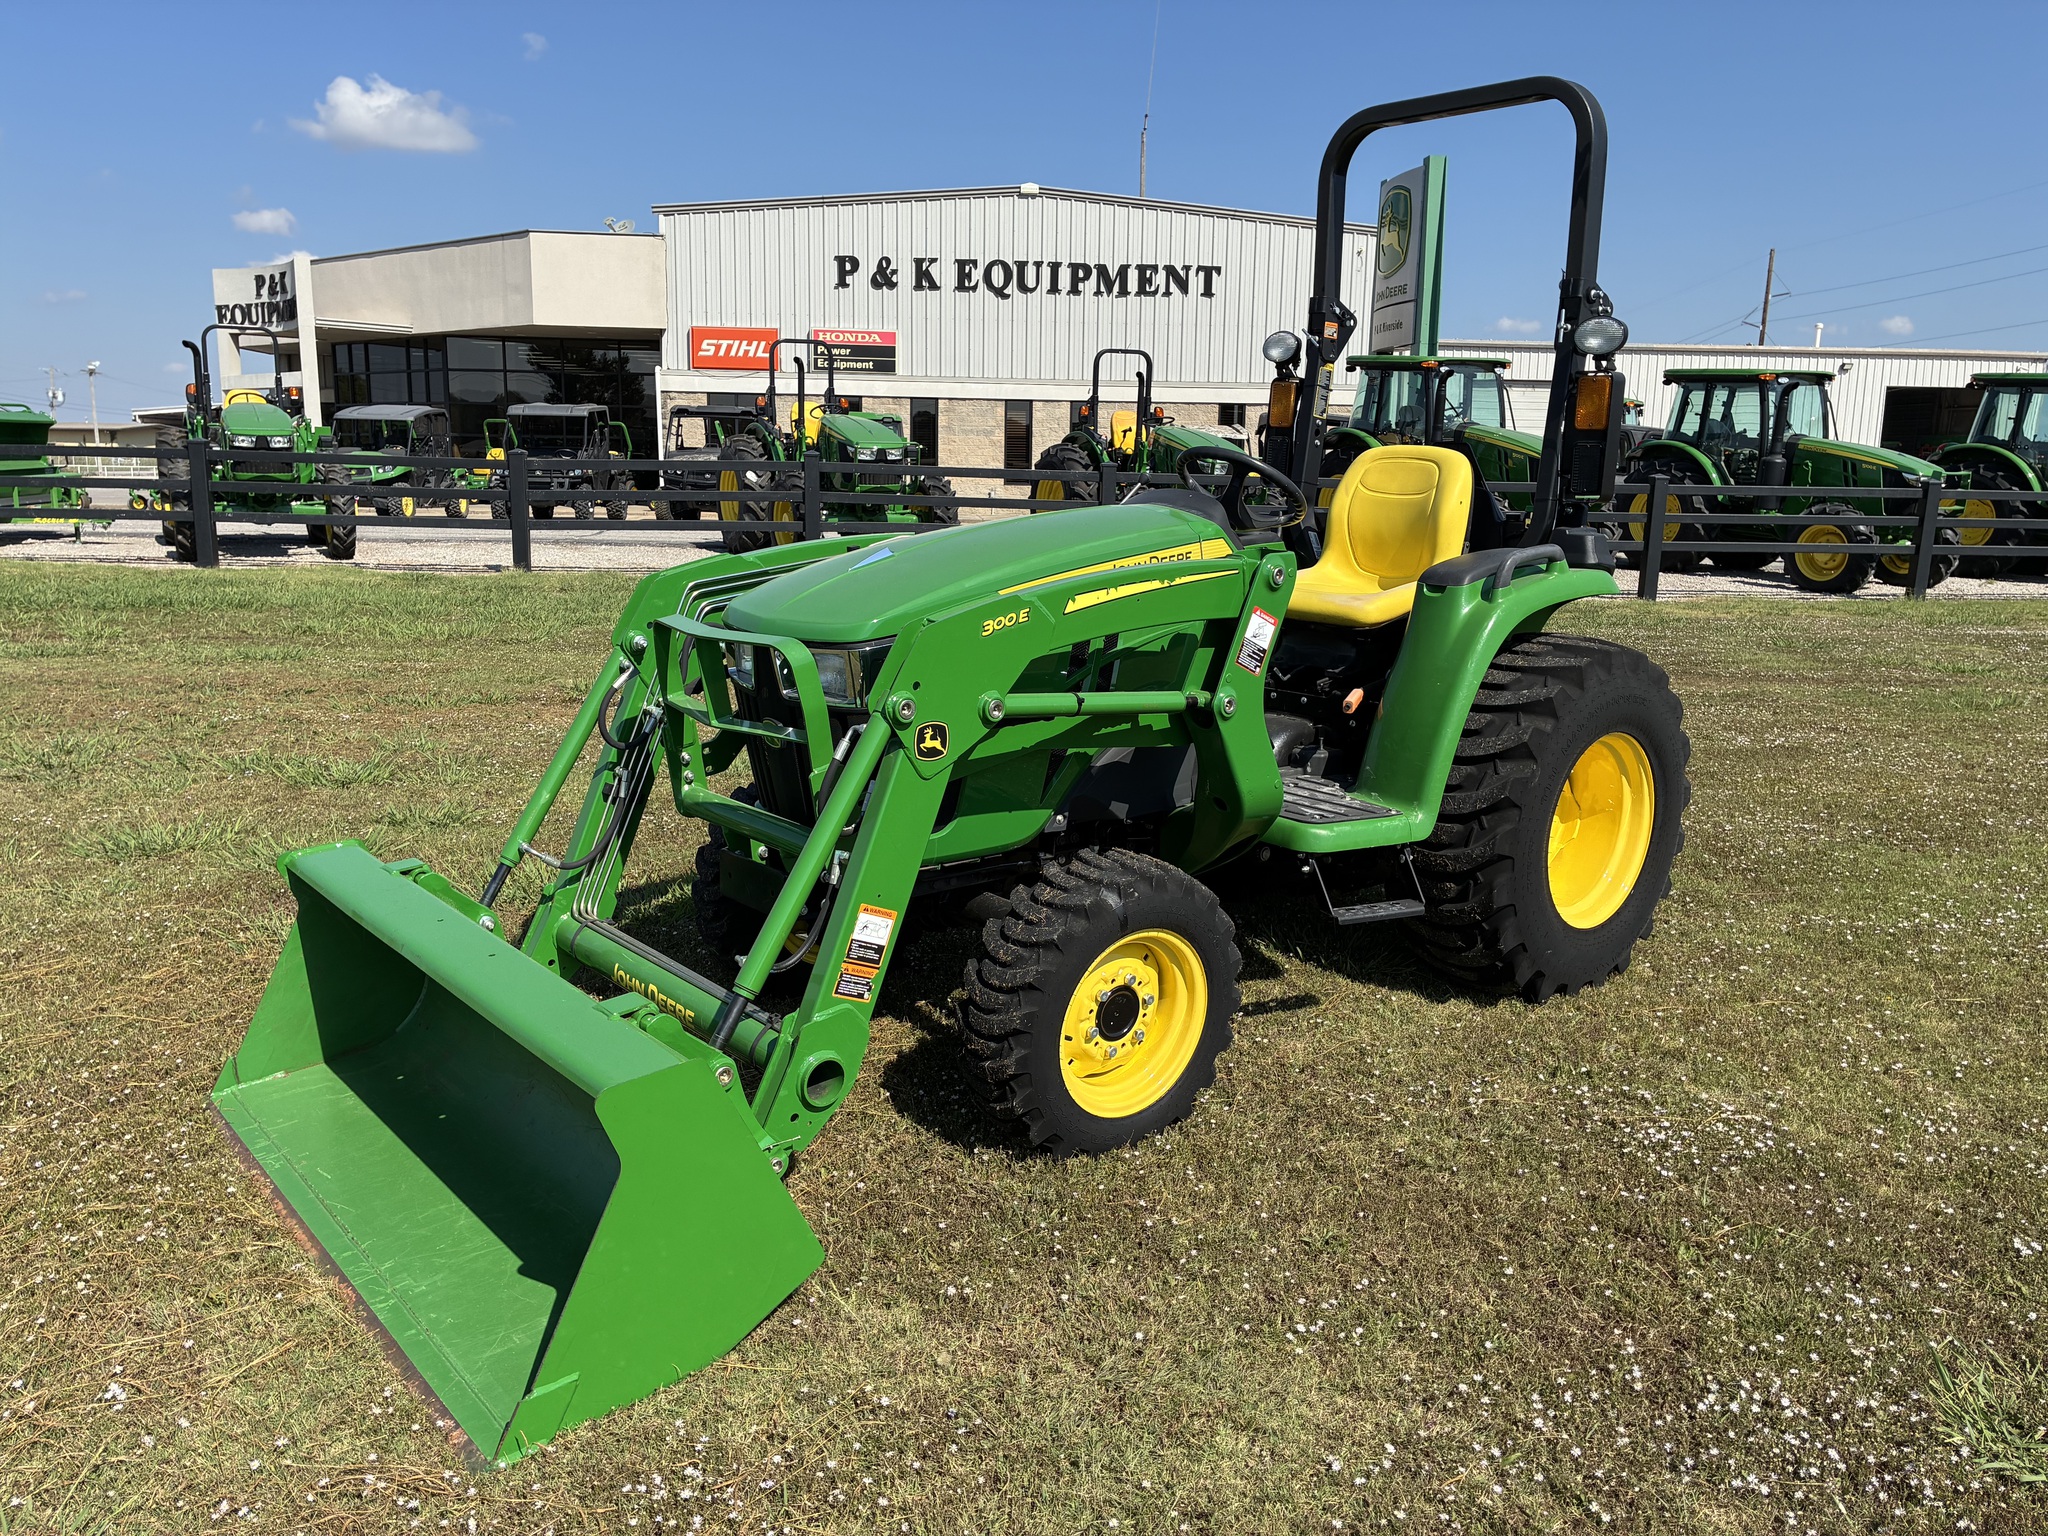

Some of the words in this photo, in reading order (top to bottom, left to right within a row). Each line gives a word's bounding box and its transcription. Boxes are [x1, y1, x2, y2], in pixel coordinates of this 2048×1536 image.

[254, 274, 267, 298] P
[833, 255, 860, 290] P
[870, 256, 898, 291] &
[912, 257, 941, 293] K
[953, 258, 1222, 300] EQUIPMENT
[1386, 283, 1408, 299] DEERE
[817, 331, 882, 343] HONDA
[697, 339, 770, 358] STIHL
[981, 612, 1018, 637] 300
[1018, 607, 1031, 624] E
[869, 907, 893, 918] WARNING
[851, 967, 874, 977] WARNING
[611, 962, 645, 997] JOHN
[647, 983, 696, 1029] DEERE
